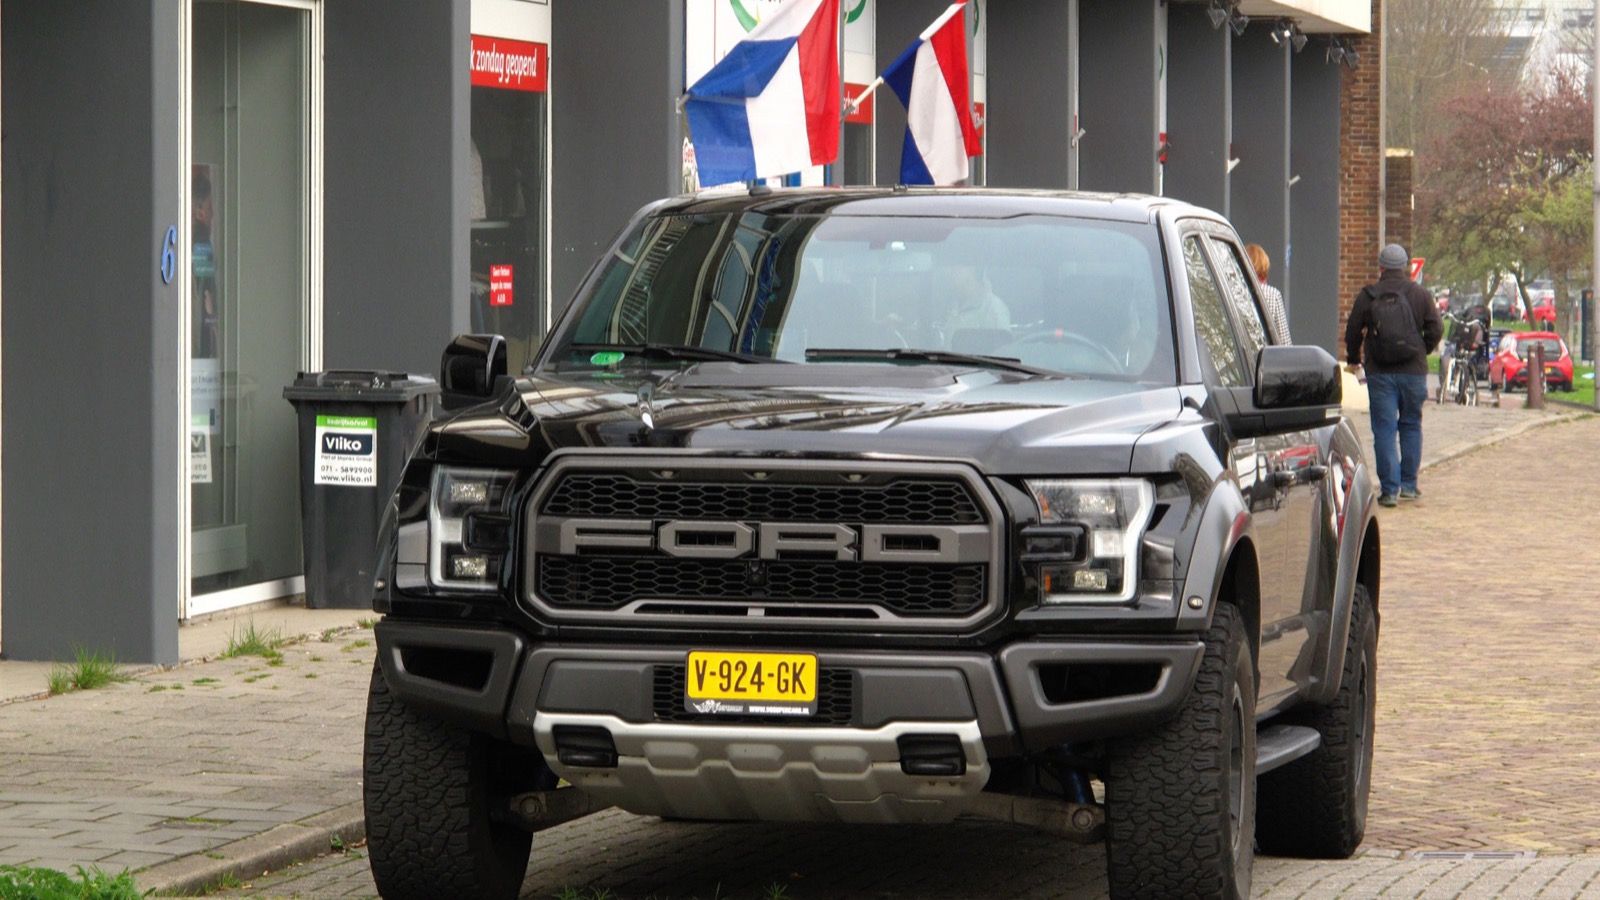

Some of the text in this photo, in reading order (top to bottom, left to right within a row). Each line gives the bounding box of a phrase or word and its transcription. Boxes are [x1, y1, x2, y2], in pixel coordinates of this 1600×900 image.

[476, 42, 504, 83] zondag
[505, 47, 537, 84] geopend
[161, 225, 177, 285] 6
[325, 436, 362, 451] Vliko
[321, 474, 372, 483] www.vliko.nl
[560, 519, 959, 563] FORD
[694, 659, 806, 694] V-924-GK
